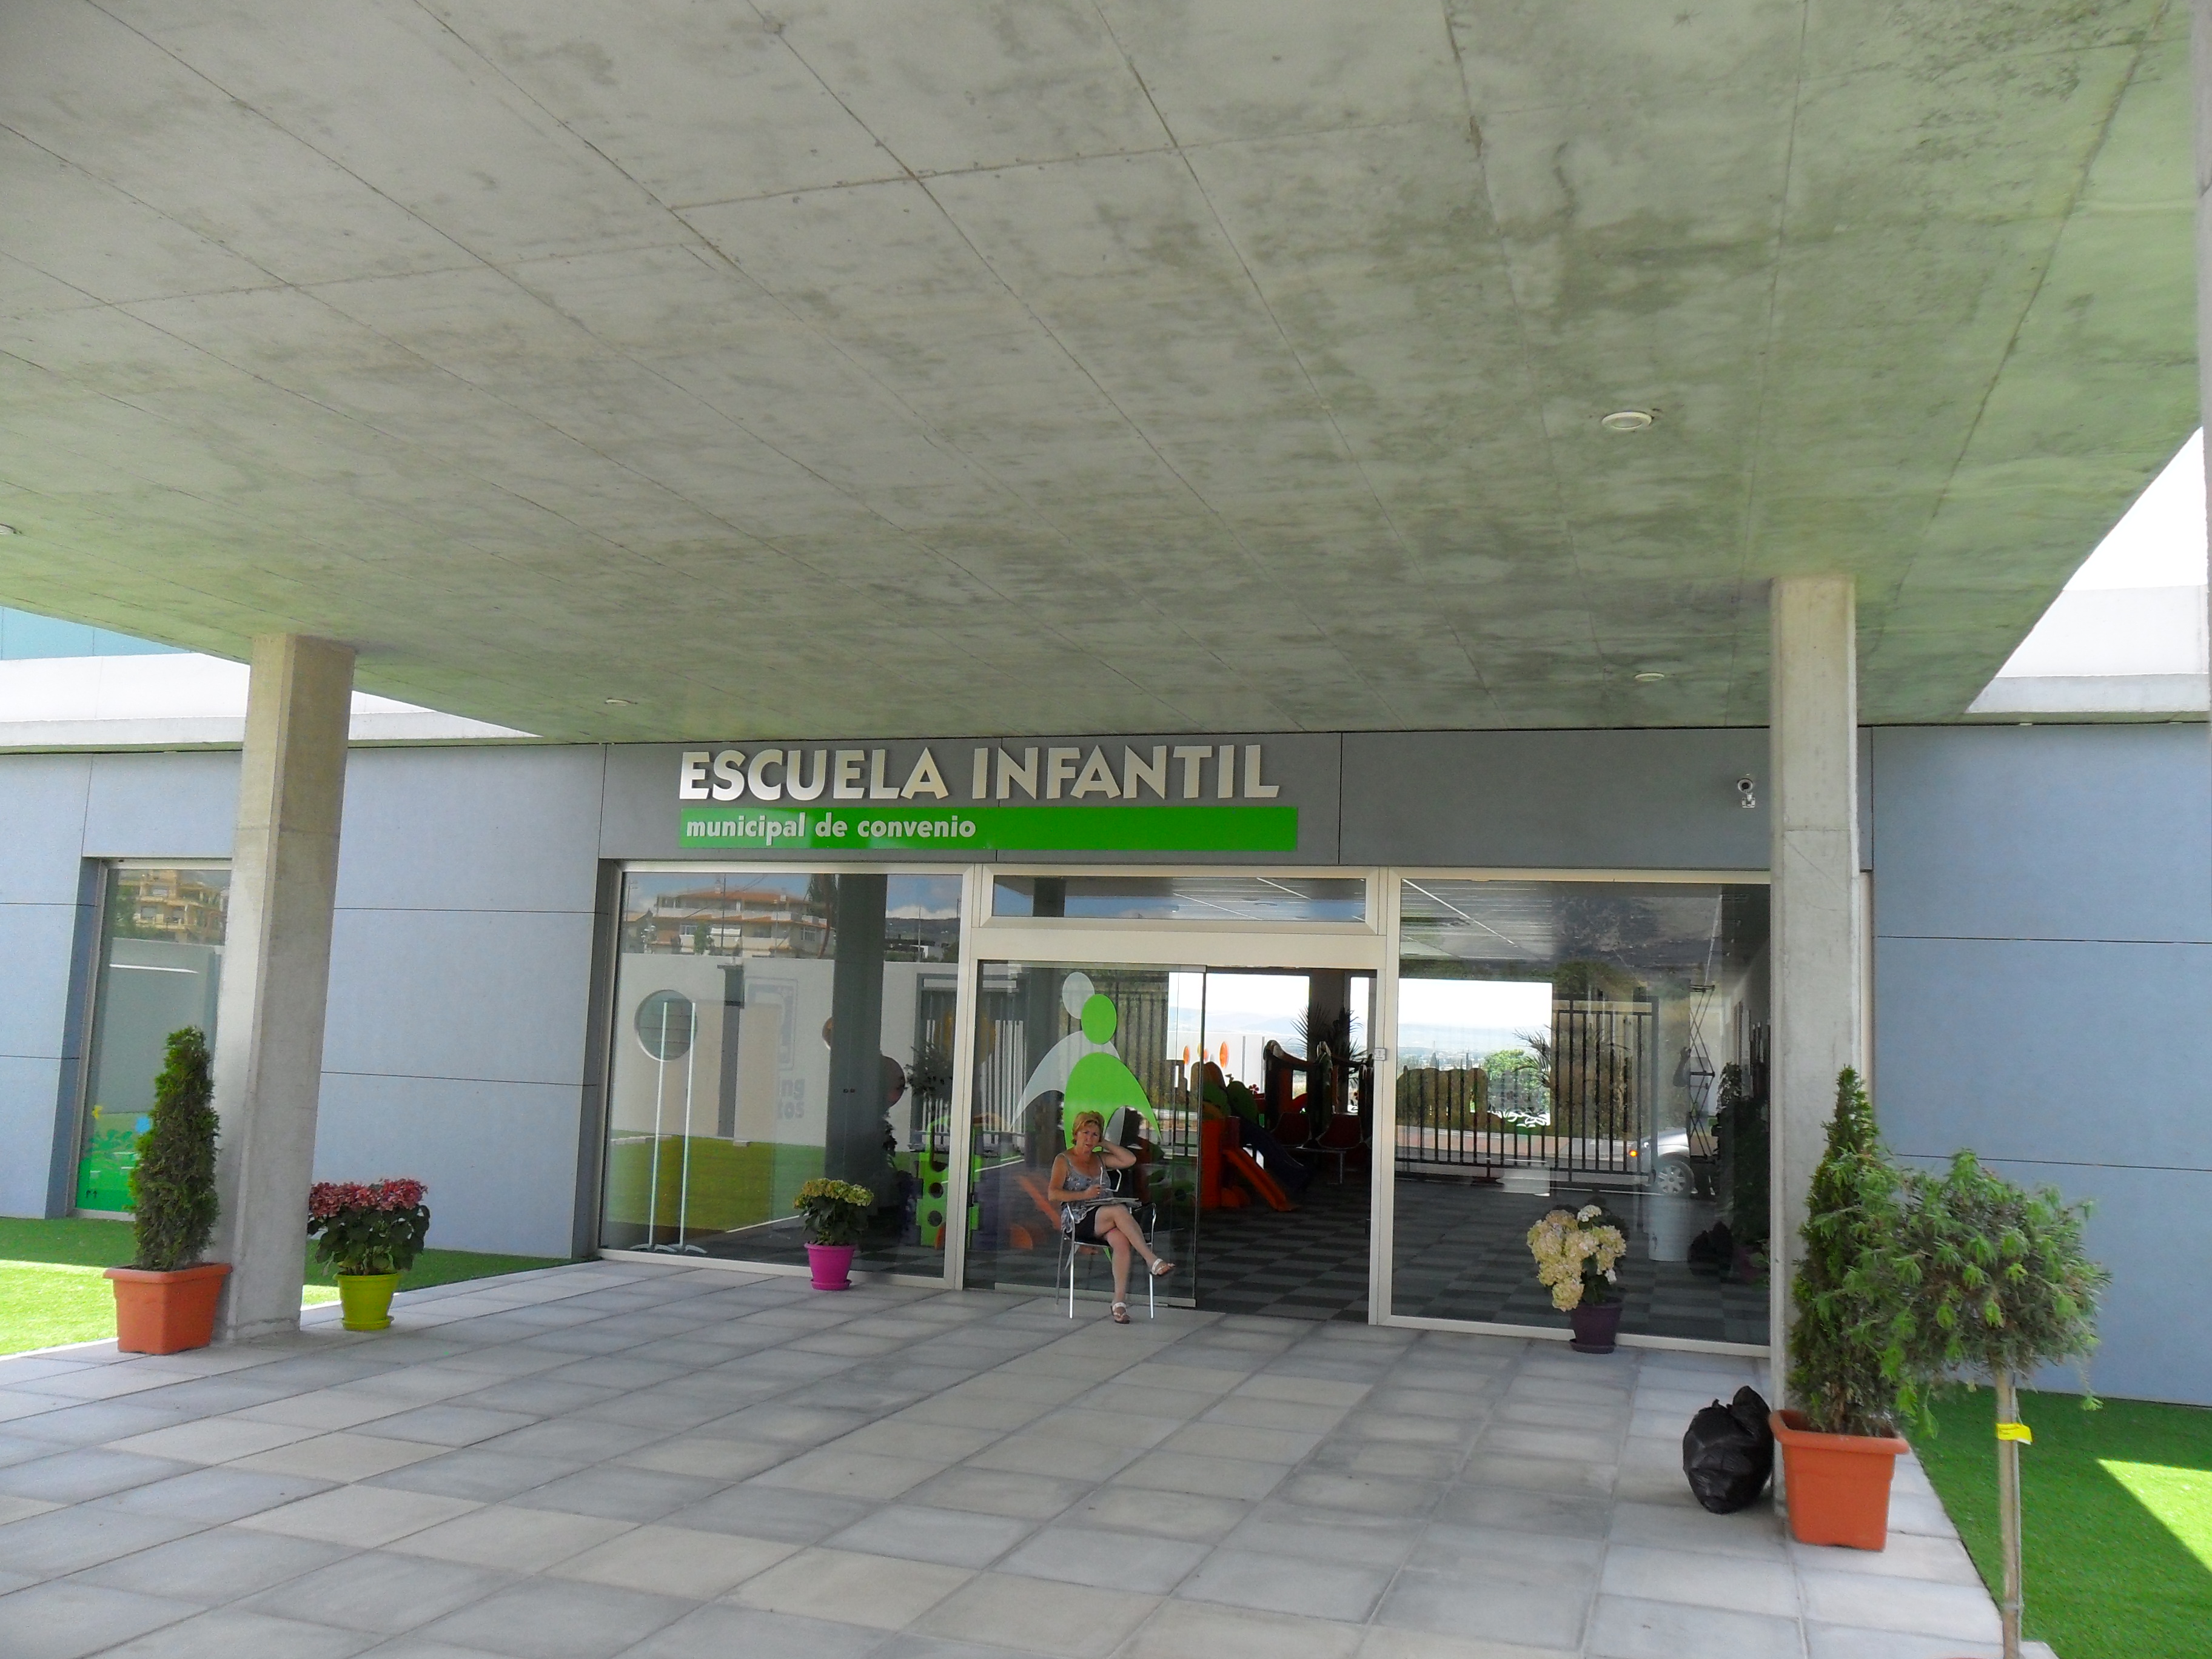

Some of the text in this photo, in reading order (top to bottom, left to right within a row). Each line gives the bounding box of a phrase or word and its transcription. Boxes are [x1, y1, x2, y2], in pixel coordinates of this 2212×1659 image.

[679, 745, 1280, 801] ESCUELA INFANTIL
[686, 812, 976, 846] municipal de convenio
